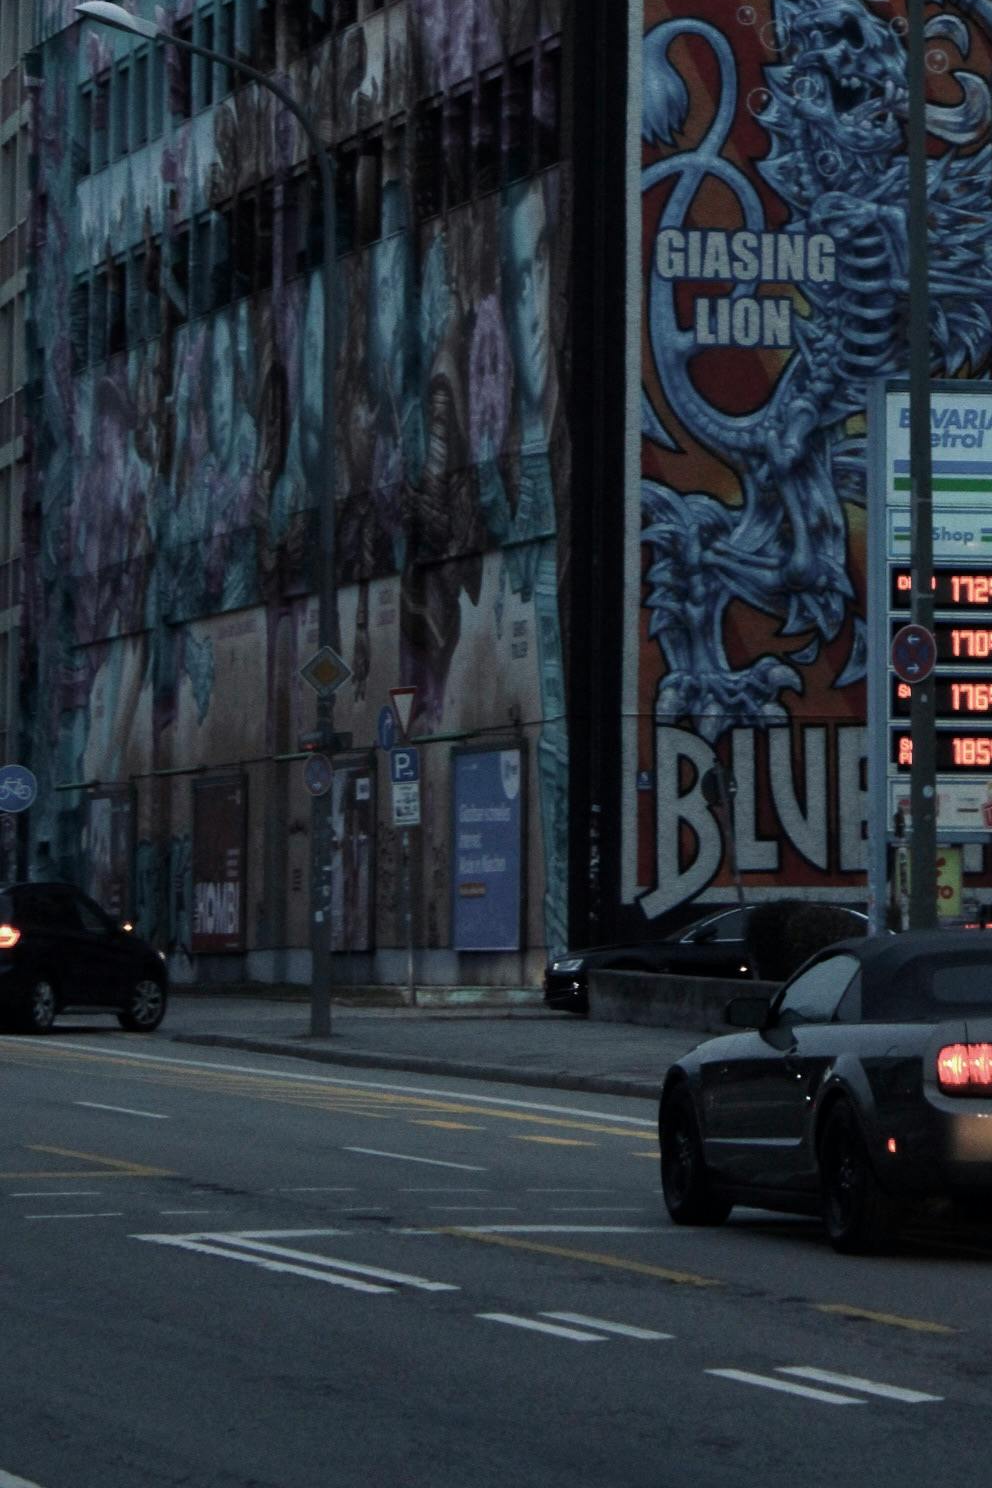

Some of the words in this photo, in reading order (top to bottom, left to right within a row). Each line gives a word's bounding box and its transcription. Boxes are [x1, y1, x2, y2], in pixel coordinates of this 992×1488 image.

[655, 228, 837, 282] GIASING
[696, 297, 791, 346] LION
[929, 431, 984, 448] etrol
[395, 753, 410, 779] P
